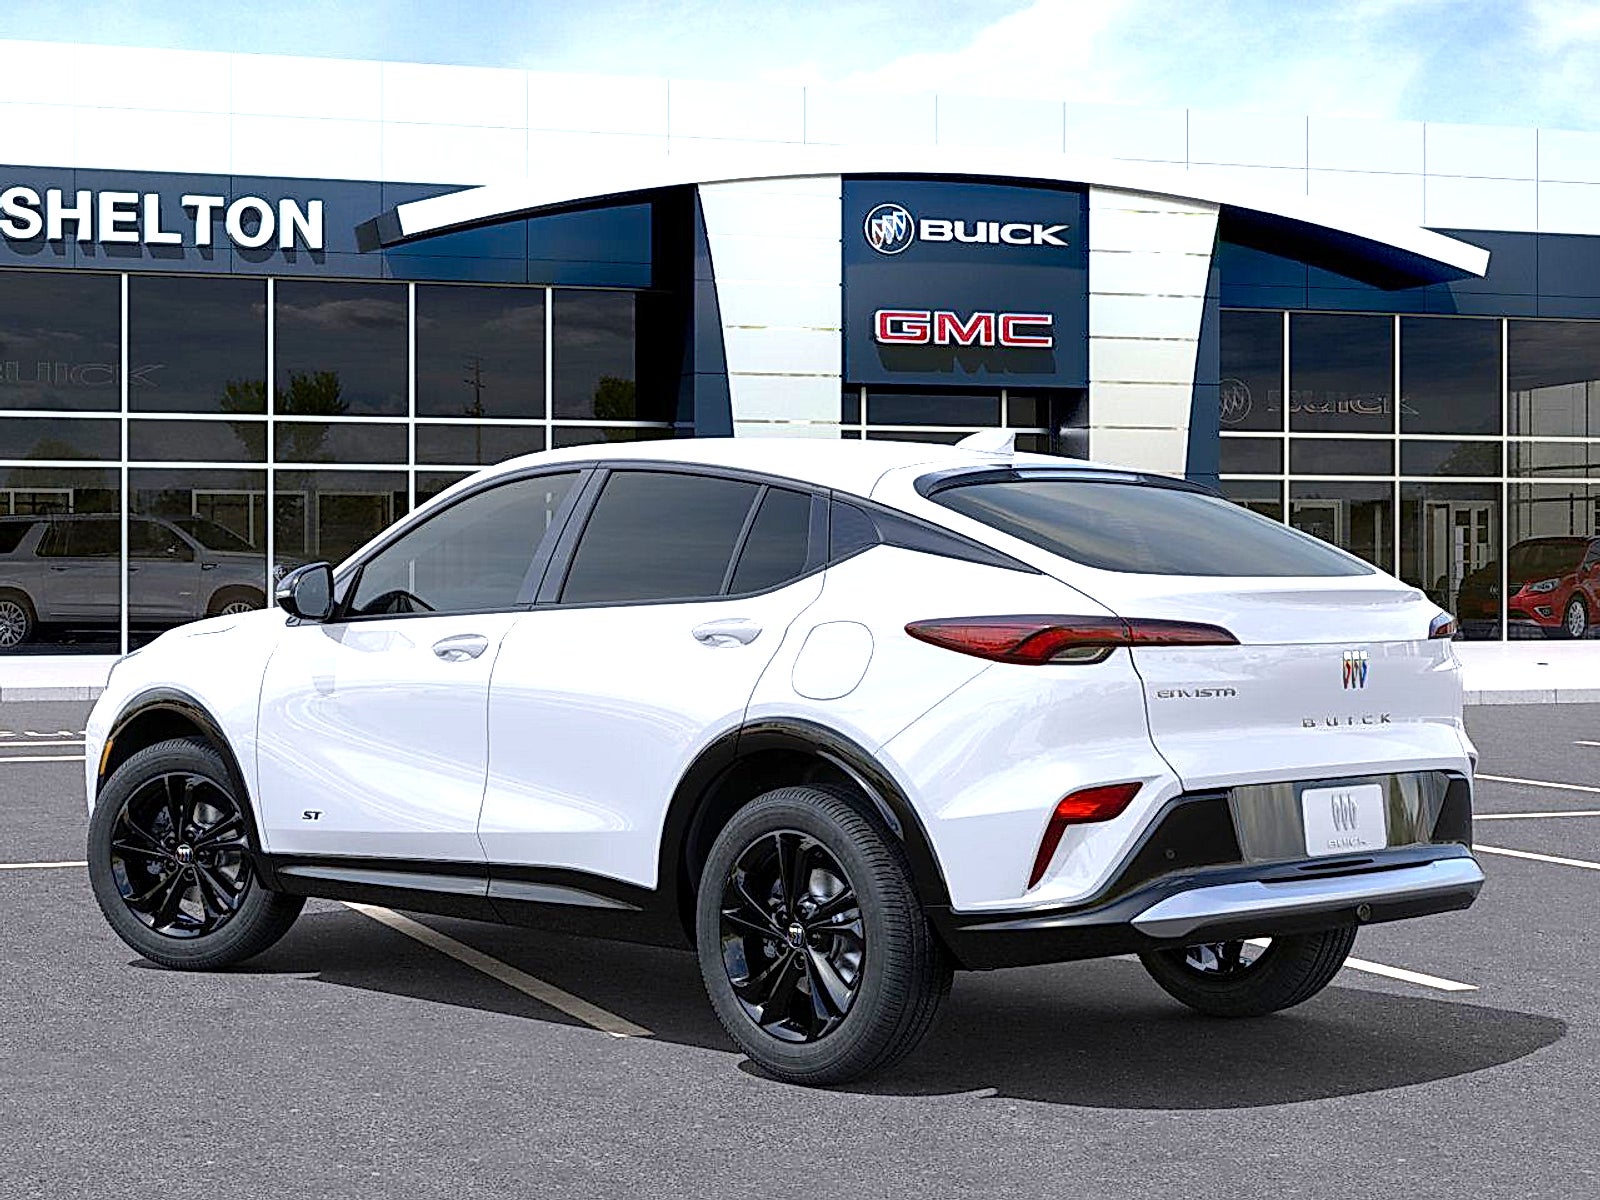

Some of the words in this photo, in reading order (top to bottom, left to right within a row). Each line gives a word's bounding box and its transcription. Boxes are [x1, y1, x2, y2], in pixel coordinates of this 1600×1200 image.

[0, 186, 324, 249] SHELTON
[920, 219, 1069, 247] BUICK
[875, 310, 1052, 347] GMC
[1302, 713, 1392, 728] BUICK
[302, 810, 322, 820] ST
